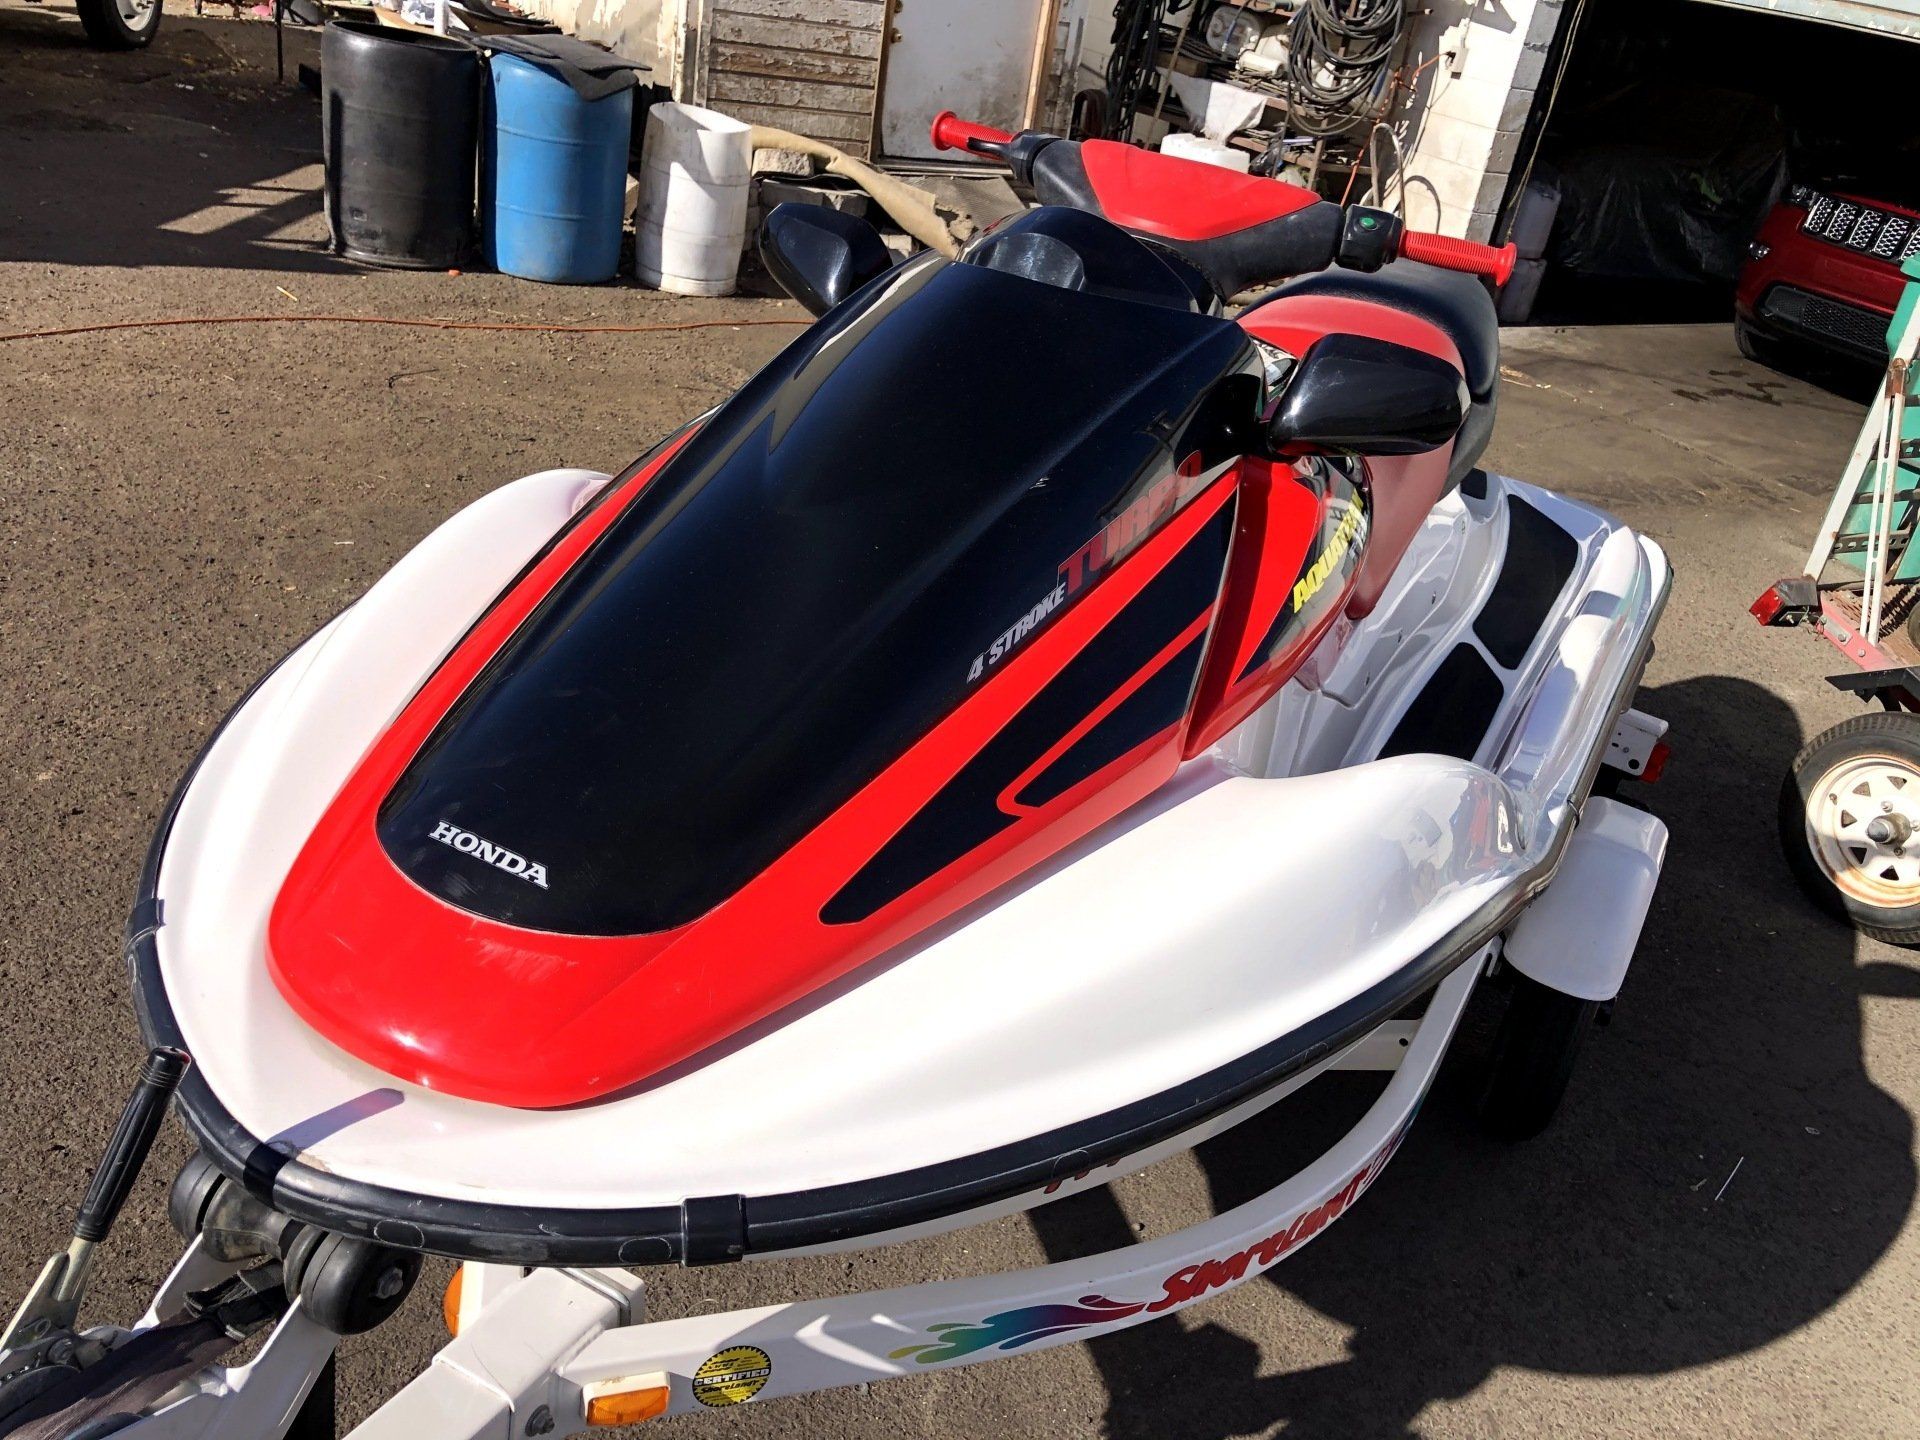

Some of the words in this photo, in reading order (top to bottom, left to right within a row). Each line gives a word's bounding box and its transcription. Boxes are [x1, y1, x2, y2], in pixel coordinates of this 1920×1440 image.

[967, 653, 985, 684] 4
[988, 582, 1066, 665] STROKE
[429, 821, 549, 888] HONDA
[693, 1368, 770, 1386] CERTIFIED
